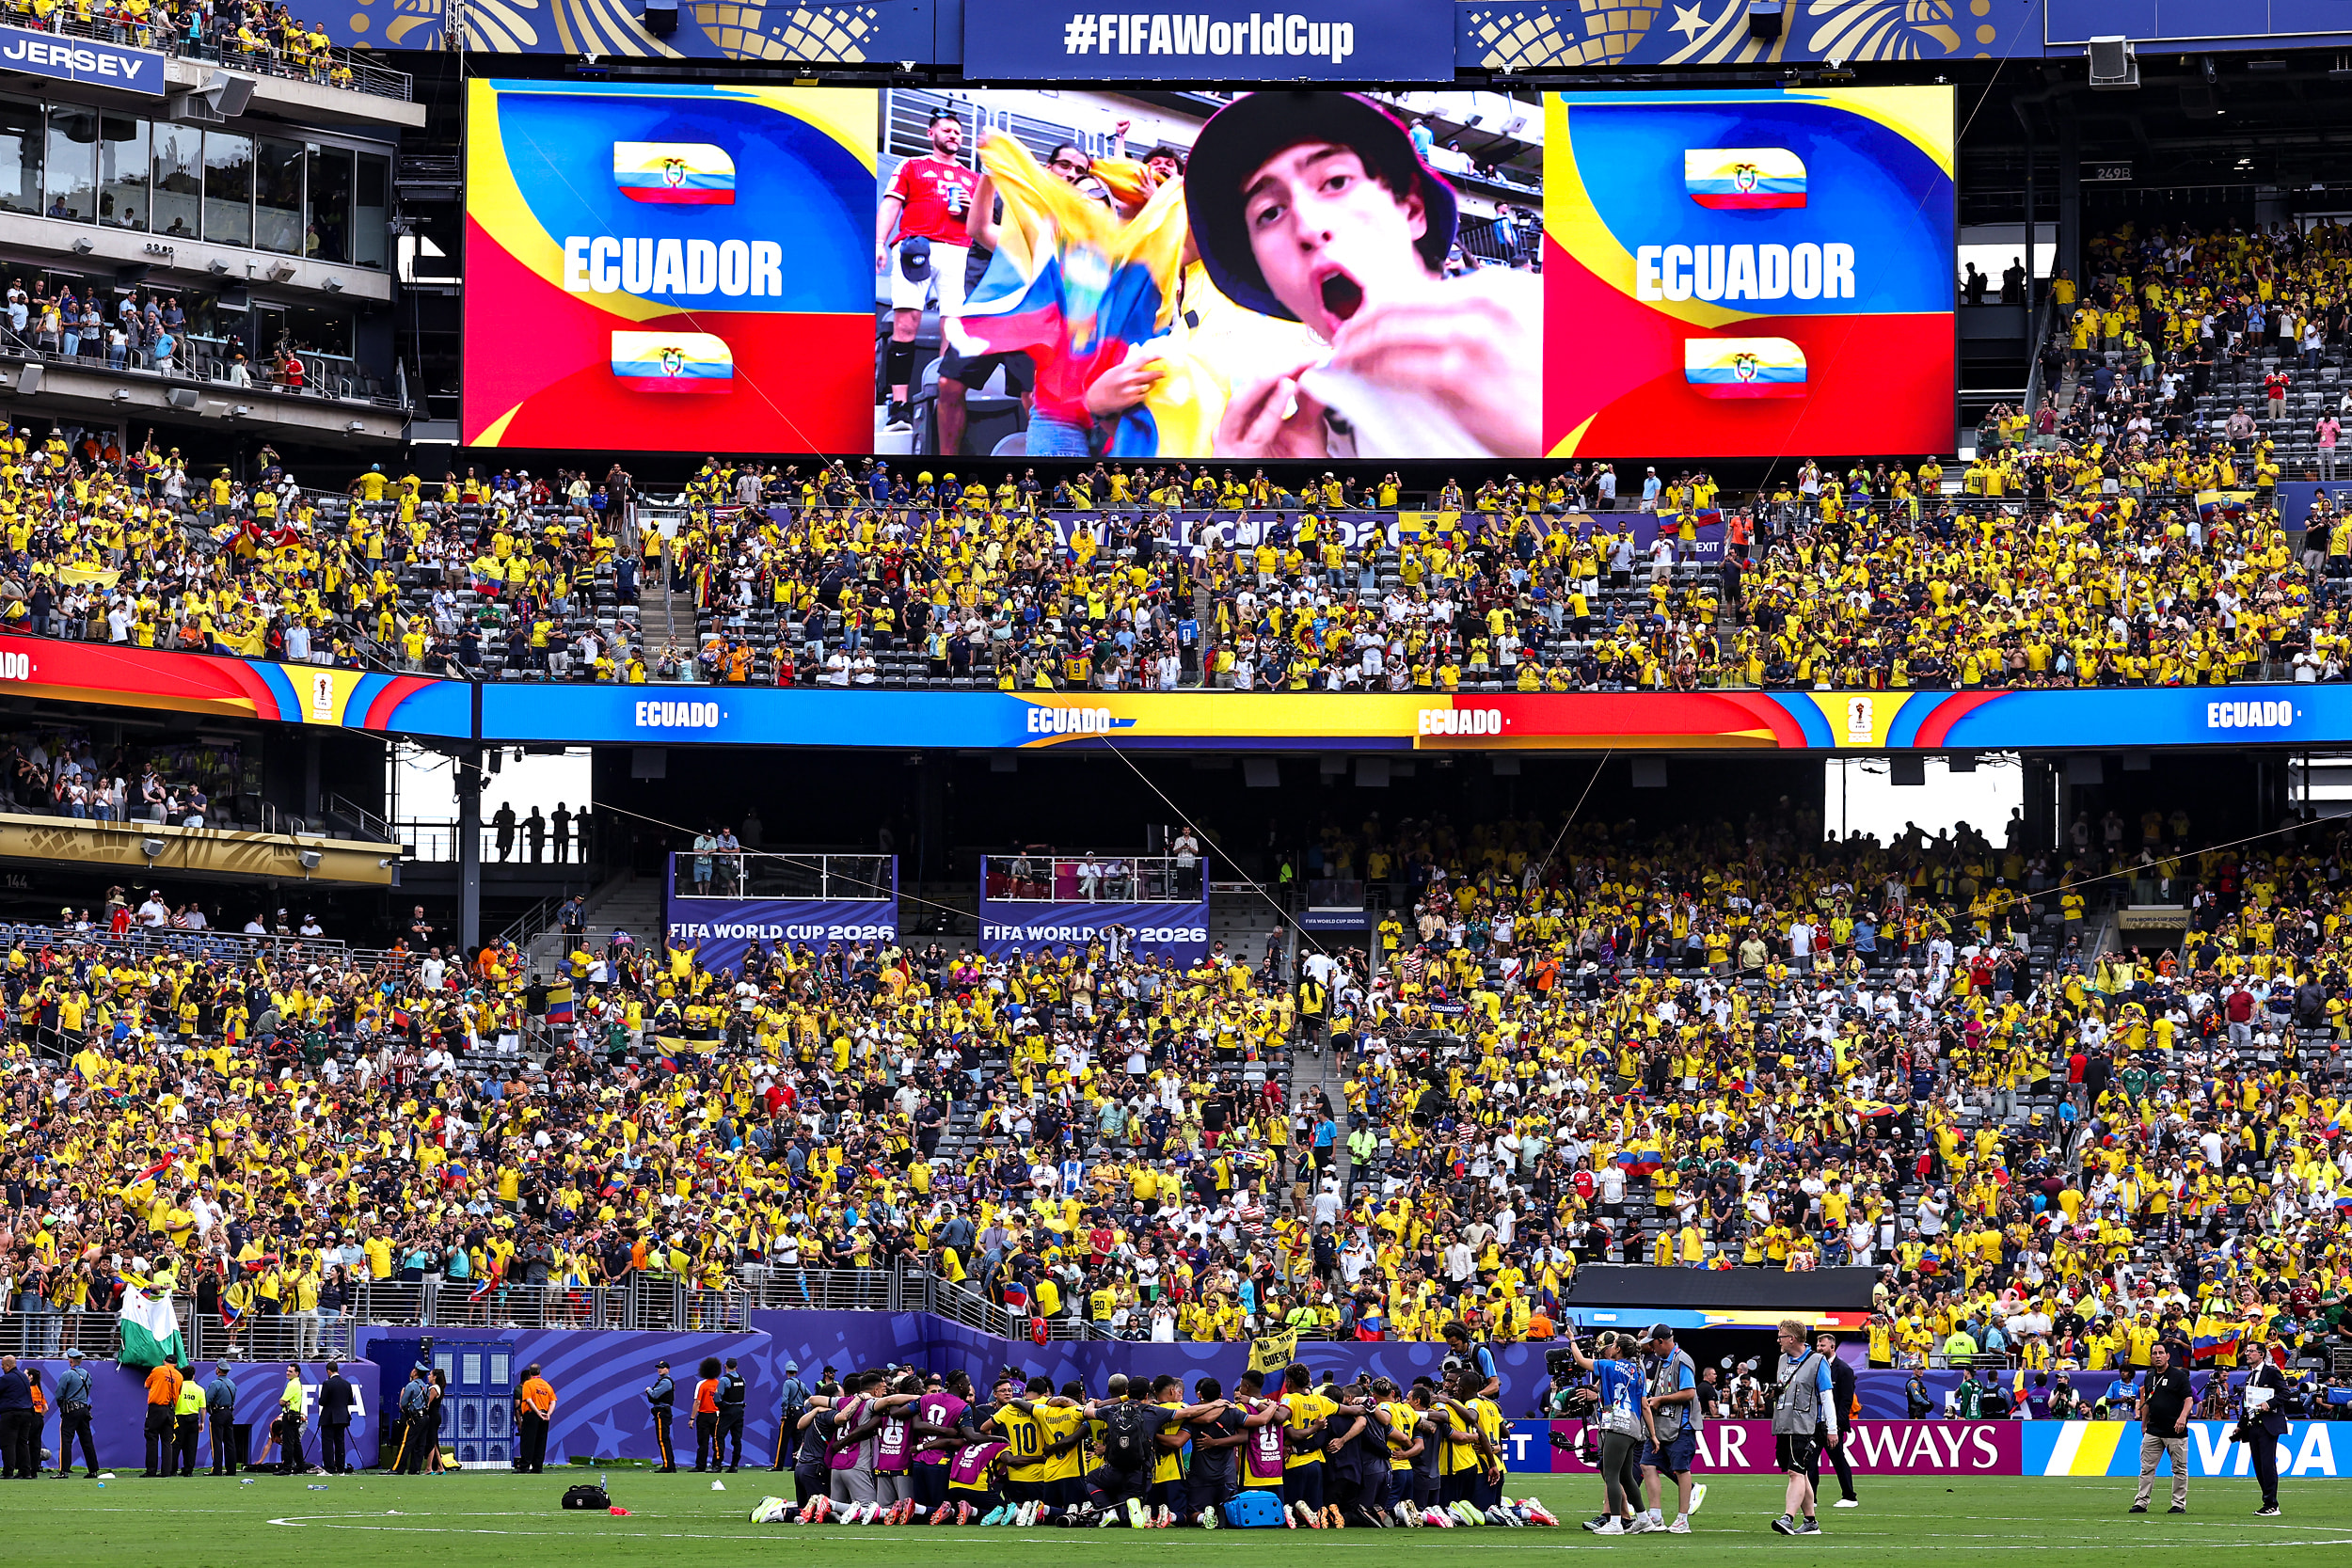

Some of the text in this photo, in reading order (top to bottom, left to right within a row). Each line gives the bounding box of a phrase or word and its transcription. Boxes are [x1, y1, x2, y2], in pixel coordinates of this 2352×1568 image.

[1063, 12, 1354, 64] #FIFAWorldCup
[3, 39, 144, 80] JERSEY
[2097, 167, 2131, 180] 249B
[564, 235, 783, 296] ECUADOR
[1636, 242, 1855, 302] ECUADOR
[1695, 542, 1720, 553] EXIT
[1073, 662, 1081, 673] 9
[670, 924, 896, 942] FIFA WORLD CUP 2026
[983, 927, 1024, 941] FIFA
[1026, 927, 1095, 942] WORLD
[1140, 927, 1208, 942] 2026
[1435, 1004, 1464, 1012] ECUADOR
[1093, 1300, 1104, 1311] 20
[1256, 1339, 1270, 1352] NO
[1013, 1422, 1038, 1456] 10
[1772, 1424, 1998, 1469] RWAYS
